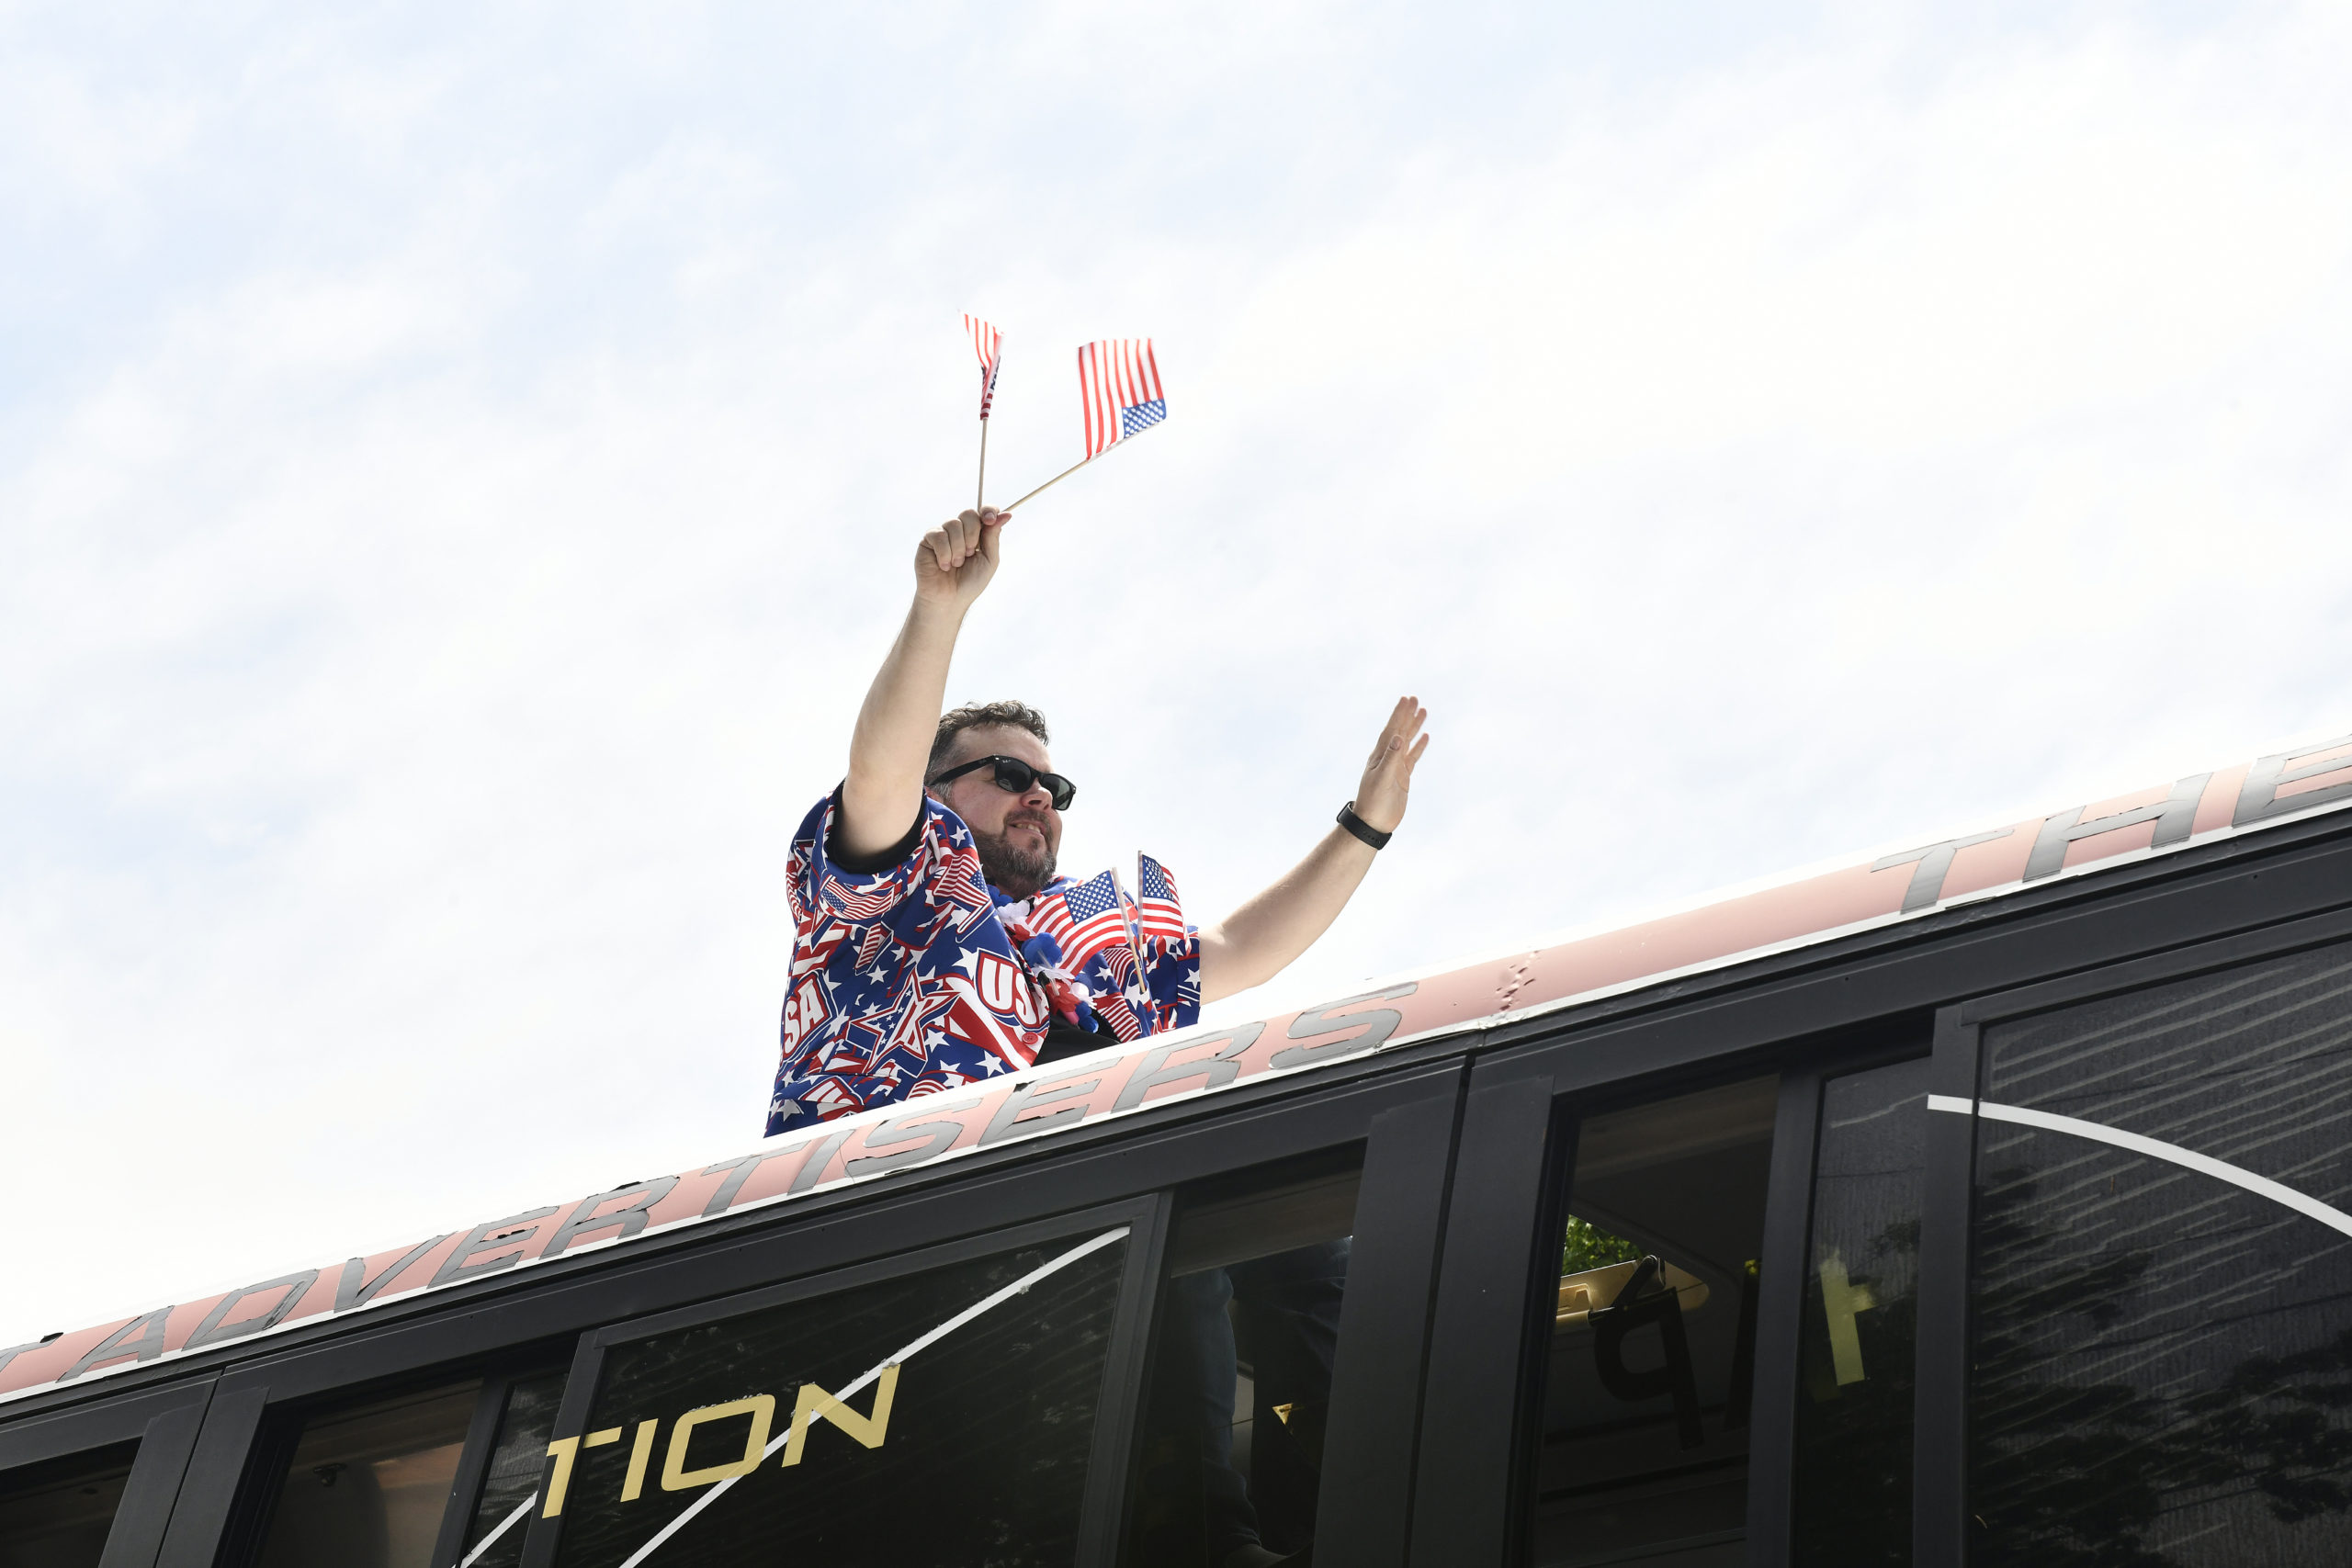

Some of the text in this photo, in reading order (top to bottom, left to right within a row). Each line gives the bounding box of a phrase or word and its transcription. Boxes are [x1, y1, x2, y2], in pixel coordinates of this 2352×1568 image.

[1871, 733, 2352, 915] THE
[55, 980, 1419, 1383] ADVERTISERS
[542, 1363, 900, 1519] TION
